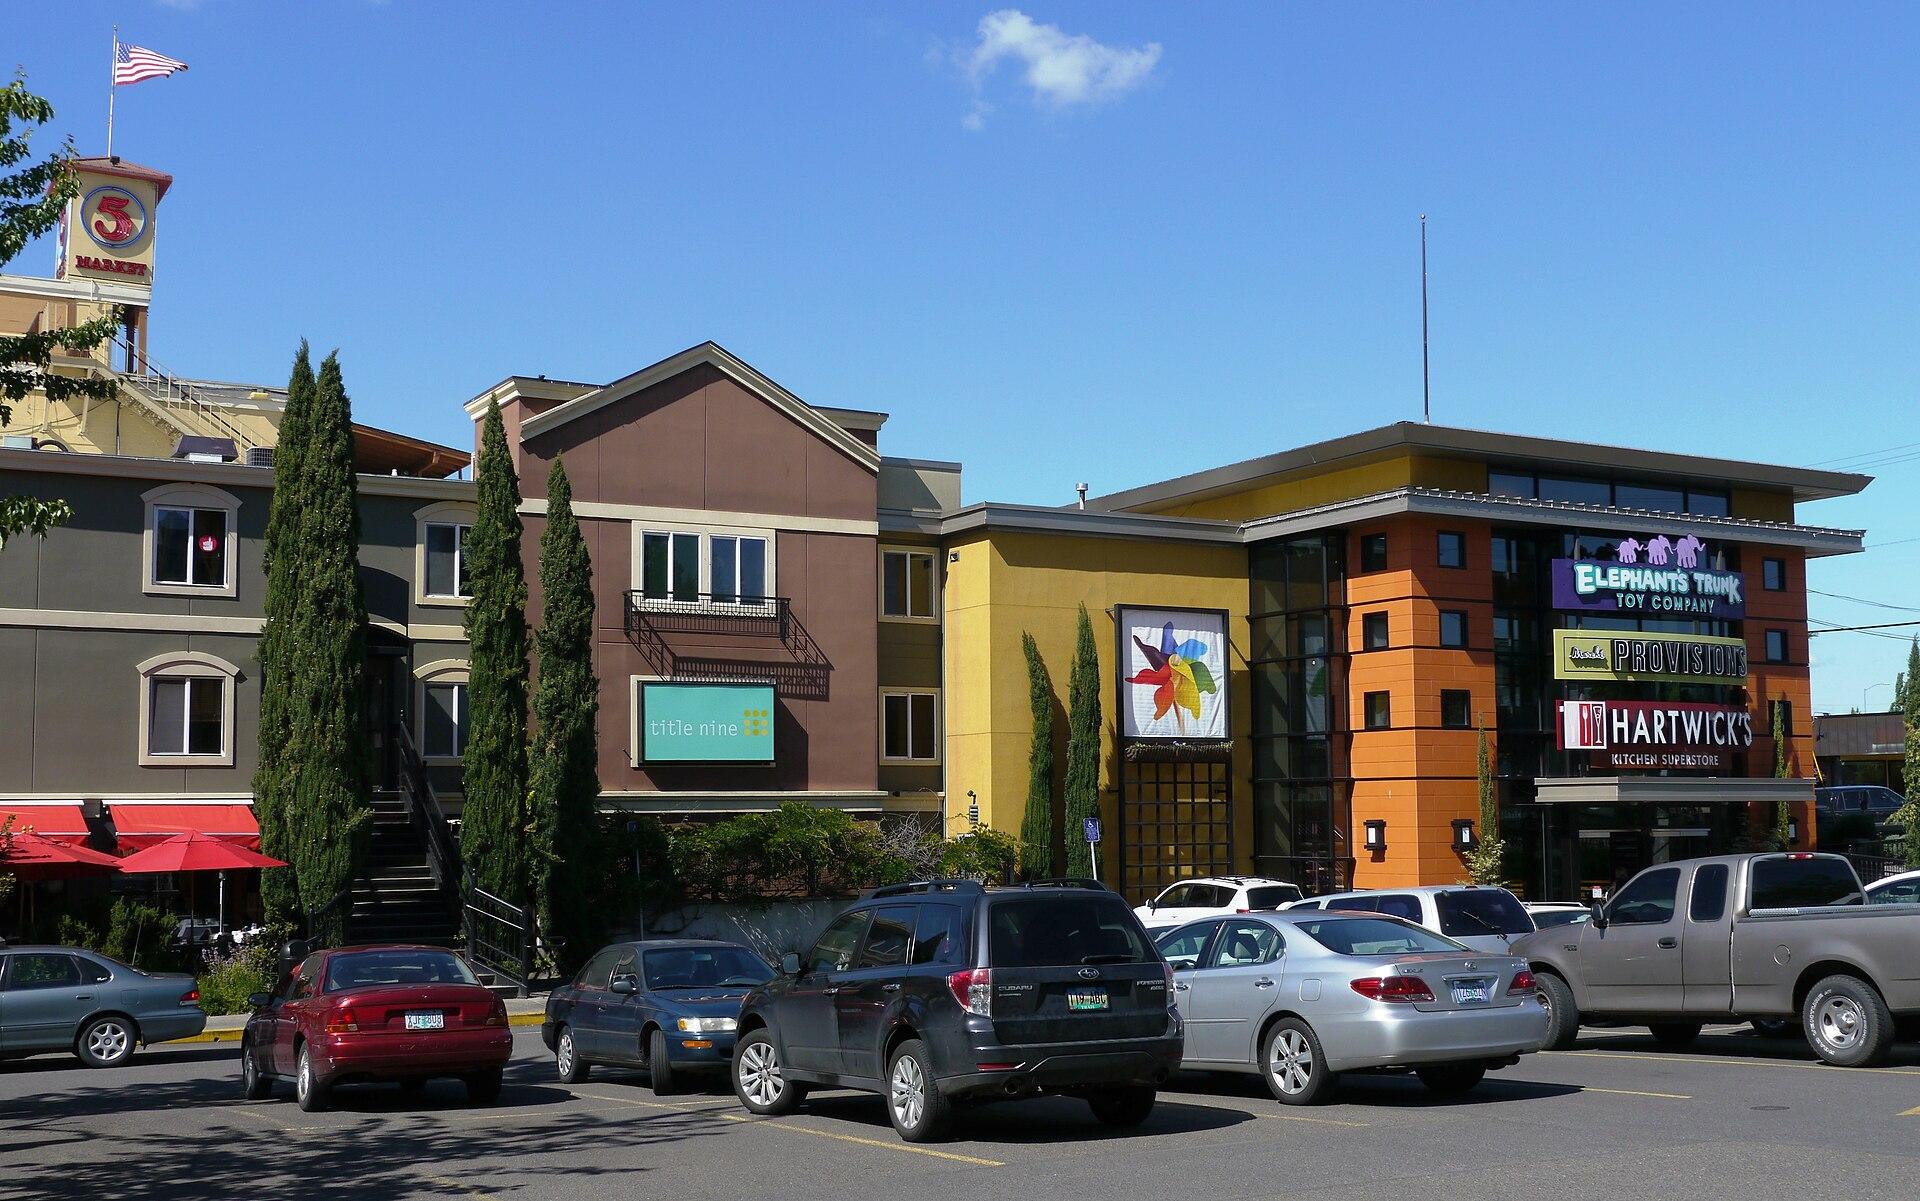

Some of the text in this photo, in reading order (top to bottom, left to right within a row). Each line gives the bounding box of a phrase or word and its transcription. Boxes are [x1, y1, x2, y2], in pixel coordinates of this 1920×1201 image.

[95, 196, 132, 241] 5
[76, 255, 147, 276] MARKET
[1693, 573, 1742, 605] TRUNK
[1616, 592, 1715, 613] TOY COMPANY
[1613, 639, 1747, 677] PROVISIONS
[650, 719, 738, 736] title nine
[1612, 708, 1753, 747] HARTWICK'S
[1611, 753, 1719, 766] KITCHEN SUPERSTORE
